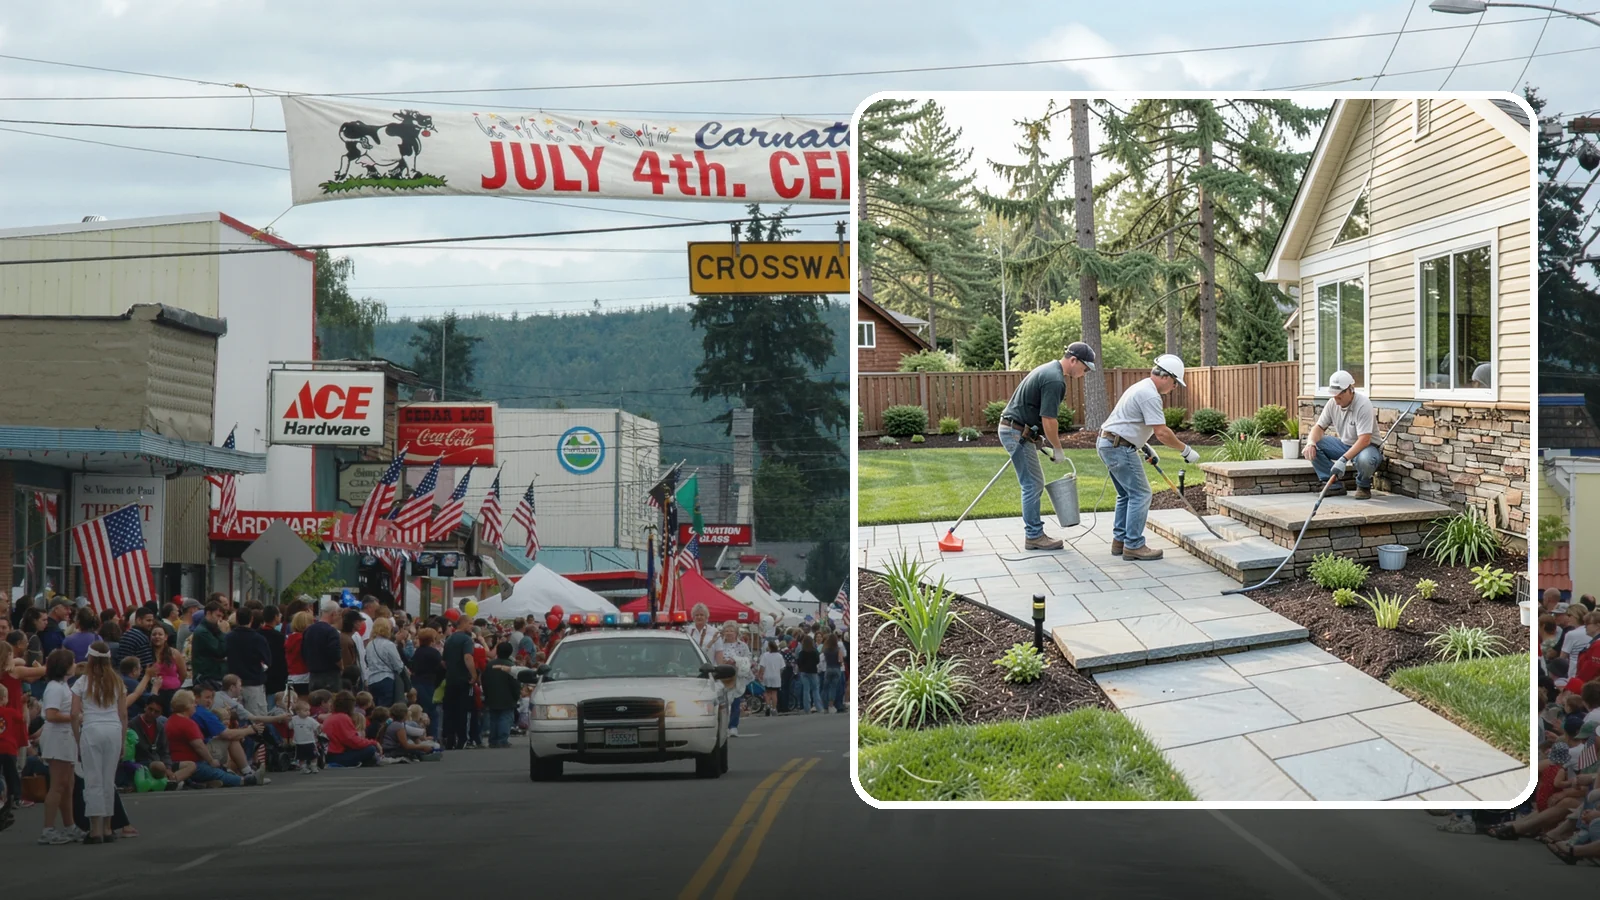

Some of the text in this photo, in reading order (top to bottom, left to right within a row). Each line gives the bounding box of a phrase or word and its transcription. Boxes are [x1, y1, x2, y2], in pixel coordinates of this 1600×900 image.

[481, 140, 605, 192] JULY
[632, 149, 746, 198] 4th.
[696, 254, 850, 280] CROSSWA
[282, 379, 374, 420] ACE
[405, 408, 453, 422] CEDAR
[283, 421, 371, 437] Hardware
[416, 427, 477, 447] Coca-Cola
[95, 485, 124, 495] Vincent
[126, 486, 136, 495] de
[137, 486, 155, 495] Paul
[688, 526, 742, 535] CRNATION
